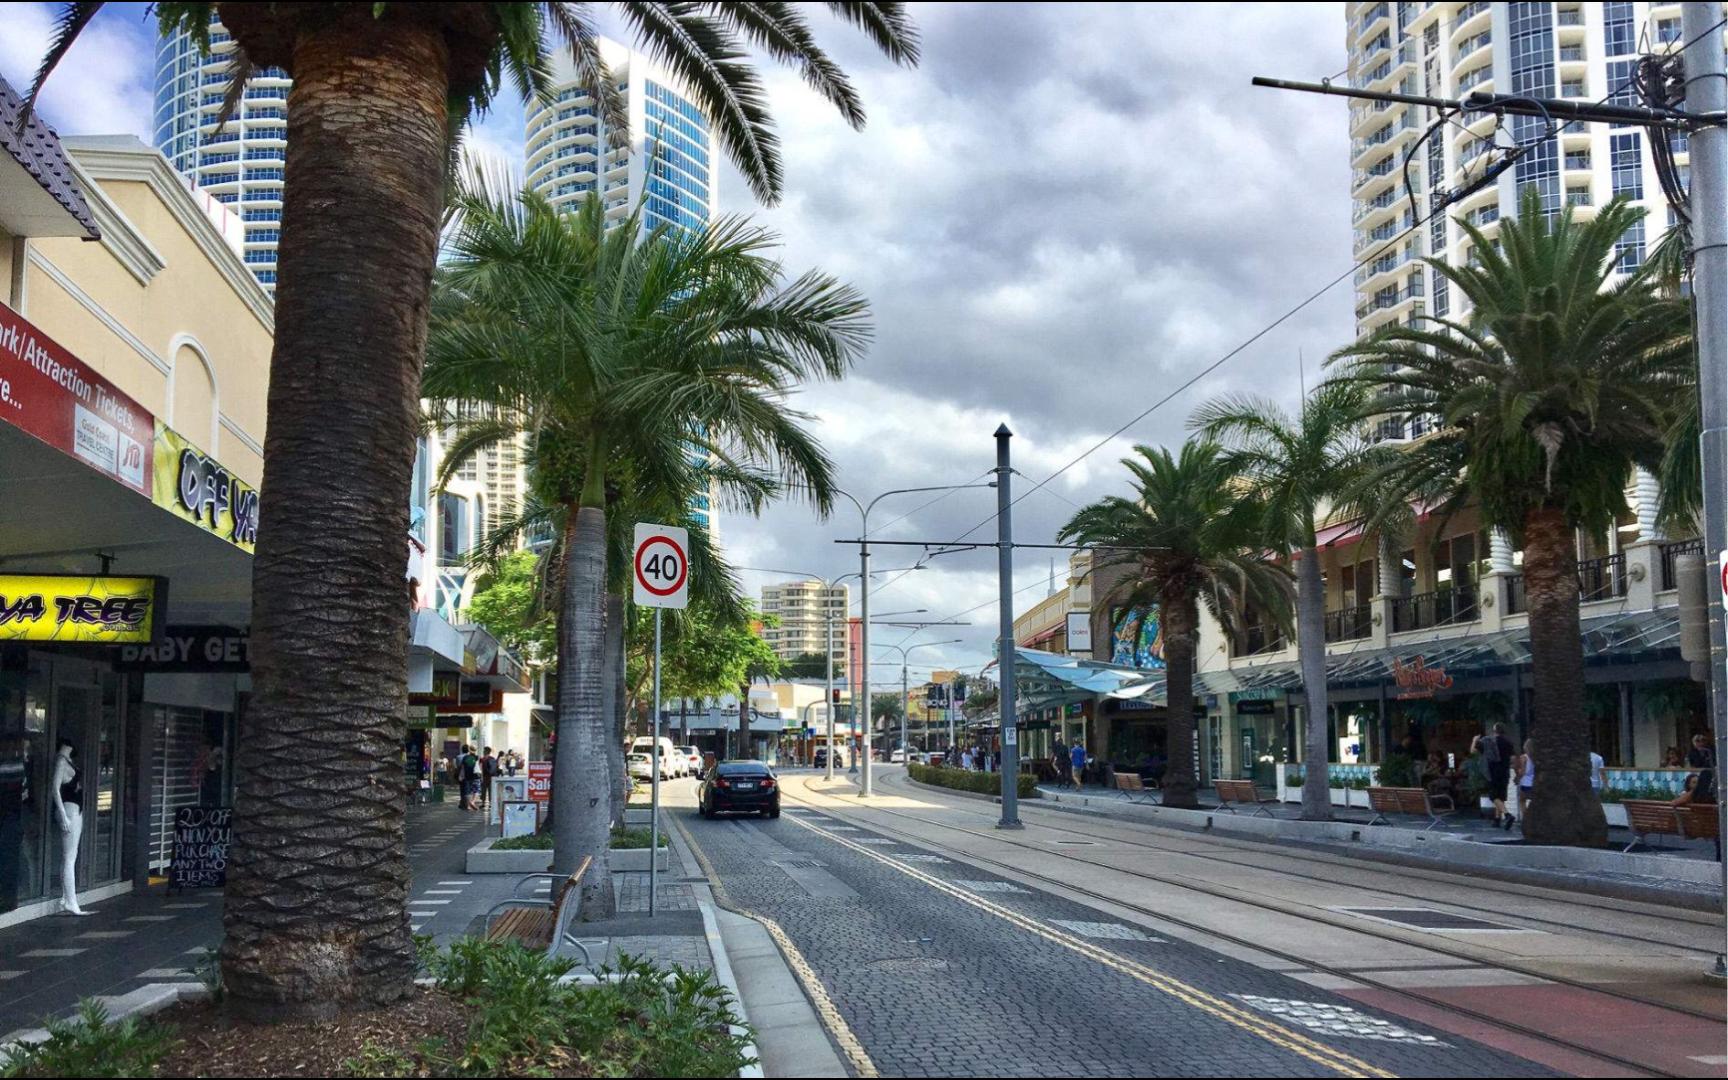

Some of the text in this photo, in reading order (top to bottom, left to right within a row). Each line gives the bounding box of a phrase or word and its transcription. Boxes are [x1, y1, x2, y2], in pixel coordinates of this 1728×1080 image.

[180, 448, 229, 528] OFF
[644, 553, 678, 581] 40
[53, 595, 151, 624] TREE
[121, 637, 195, 662] BABY
[171, 859, 197, 871] ANY
